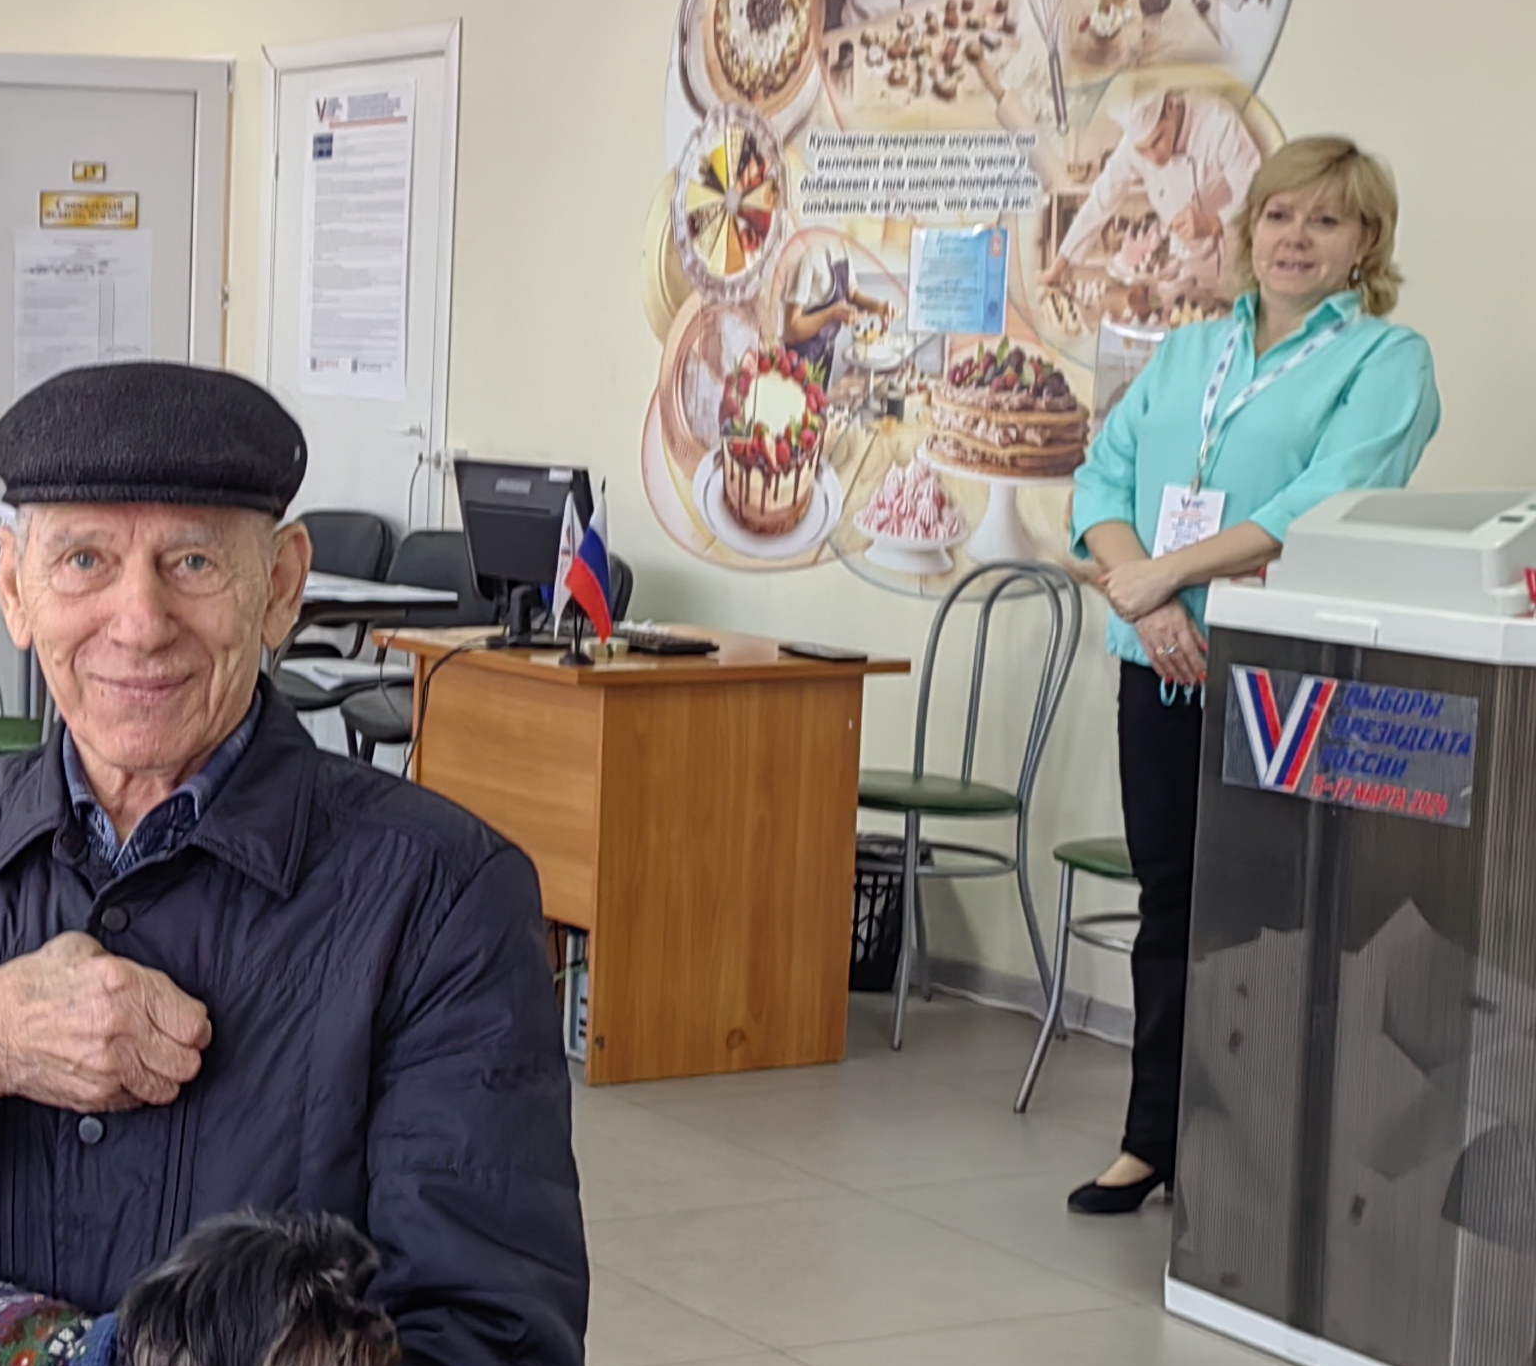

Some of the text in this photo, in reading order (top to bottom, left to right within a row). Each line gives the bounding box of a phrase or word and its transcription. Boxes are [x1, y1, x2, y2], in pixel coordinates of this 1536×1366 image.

[1343, 682, 1445, 719] ВЫБОРЫ
[1331, 714, 1473, 757] ПРЕЗИДЕНТА
[1319, 744, 1409, 781] РОССИИ
[1351, 782, 1408, 809] МАРТА
[1408, 790, 1450, 817] 2024
